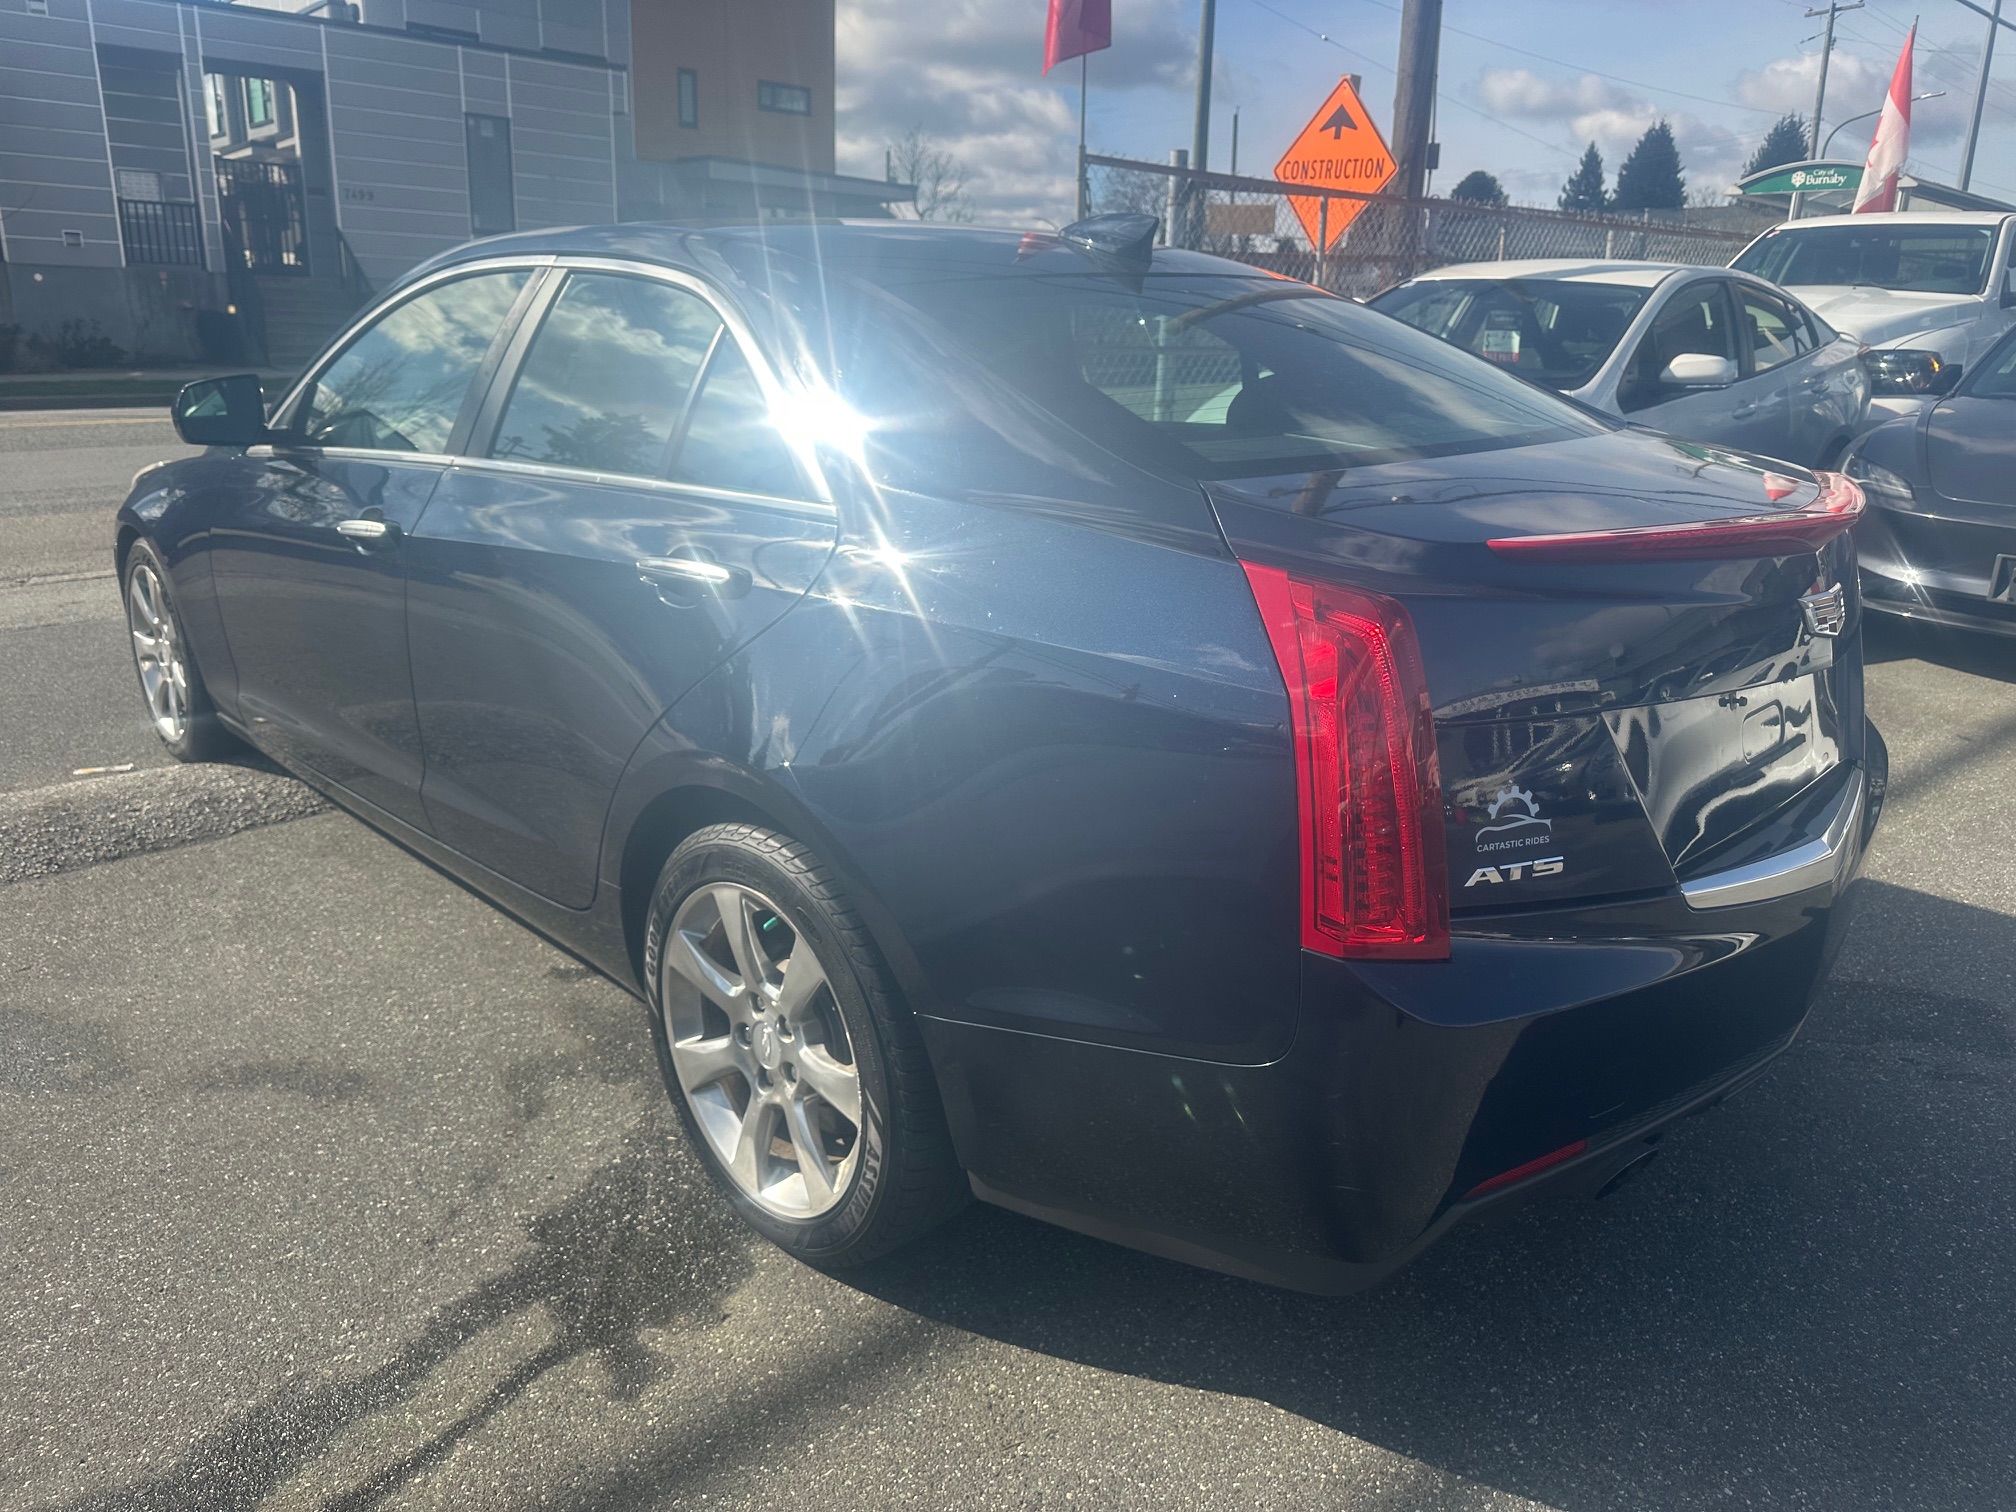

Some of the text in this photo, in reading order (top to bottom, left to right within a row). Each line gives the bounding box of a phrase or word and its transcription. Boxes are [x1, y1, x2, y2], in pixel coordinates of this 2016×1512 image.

[1282, 158, 1385, 180] CONSTRUCTION
[1813, 169, 1827, 177] City
[1805, 173, 1847, 186] Burnaby
[1476, 835, 1550, 853] CARTASTIC RIDES
[1464, 856, 1564, 887] ATS
